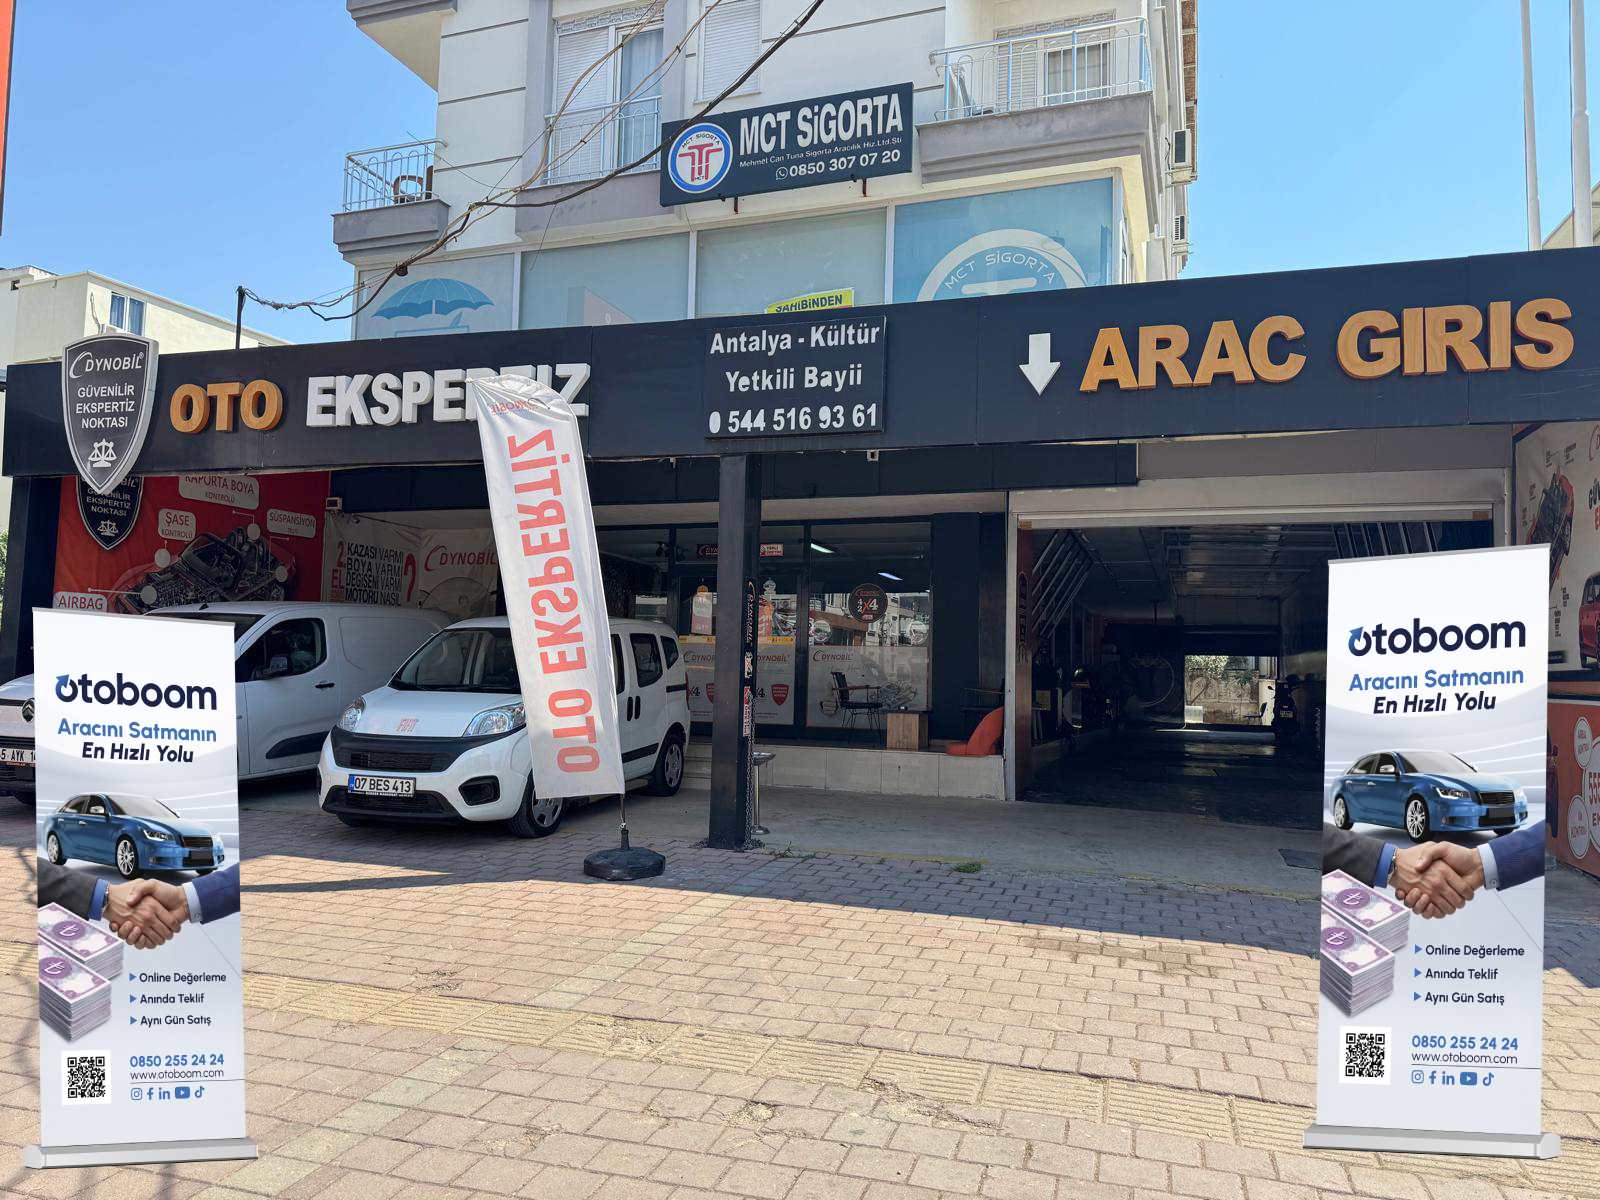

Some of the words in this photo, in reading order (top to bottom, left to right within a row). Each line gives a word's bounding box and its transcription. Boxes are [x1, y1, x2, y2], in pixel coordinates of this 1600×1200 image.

[740, 111, 791, 156] MCT
[740, 158, 768, 168] Mehmet
[770, 154, 784, 164] Can
[786, 152, 804, 161] Tuna
[806, 148, 832, 159] Sigorta
[789, 162, 825, 176] 0850
[829, 155, 856, 171] 307
[860, 152, 877, 167] 07
[882, 149, 900, 163] 20
[944, 260, 976, 290] MCT
[709, 330, 792, 356] Antalya
[810, 323, 880, 348] Kültür
[1079, 315, 1306, 393] ARAC
[1336, 297, 1576, 381] GIRIS
[725, 367, 795, 392] Yetkili
[804, 363, 862, 392] Bayii
[77, 383, 135, 397] GÜVENİLİR
[76, 398, 135, 413] EKSPERTİZ
[170, 378, 283, 434] OTO
[306, 363, 591, 427] EKSPEZ
[82, 417, 128, 428] NOKTASI
[709, 411, 721, 434] 0
[728, 408, 766, 433] 544
[772, 406, 812, 431] 516
[818, 405, 845, 429] 93
[852, 403, 877, 428] 61
[231, 480, 254, 494] BOYA
[165, 512, 190, 526] ŞASE
[347, 542, 377, 559] KAZASI
[347, 557, 373, 573] BOYA
[58, 595, 103, 609] AIRBAG
[1348, 618, 1526, 657] otoboom
[1349, 672, 1418, 691] Aracını
[1424, 669, 1524, 688] Satmanın
[55, 673, 217, 710] otoboom
[1373, 697, 1397, 715] En
[1403, 693, 1447, 713] Hızlı
[1456, 691, 1496, 712] Yolu
[58, 718, 123, 737] Aracını
[129, 721, 217, 742] Satmanın
[11, 750, 24, 761] AYK
[82, 742, 105, 759] En
[110, 743, 150, 762] Hızlı
[157, 745, 194, 763] Yolu
[354, 777, 367, 789] 07
[369, 779, 390, 791] BES
[392, 780, 411, 793] 413
[1425, 944, 1461, 956] Online
[1464, 945, 1525, 958] Değerleme
[139, 972, 171, 982] Online
[173, 972, 227, 985] Değerleme
[1425, 968, 1464, 979] Anında
[1468, 968, 1498, 980] Teklif
[140, 994, 176, 1004] Anında
[178, 993, 205, 1003] Teklif
[1425, 992, 1448, 1005] Aynı
[1451, 992, 1474, 1003] Gün
[1477, 992, 1505, 1005] Satış
[140, 1015, 162, 1028] Aynı
[164, 1014, 185, 1025] Gün
[187, 1015, 212, 1026] Satış
[1412, 1035, 1446, 1048] 0850
[1450, 1036, 1476, 1049] 255
[1480, 1037, 1497, 1050] 24
[1501, 1037, 1518, 1050] 24
[130, 1055, 161, 1067] 0850
[165, 1055, 188, 1066] 255
[191, 1054, 206, 1065] 24
[209, 1054, 224, 1065] 24
[1411, 1052, 1518, 1064] www.otoboom.com
[130, 1069, 224, 1080] www.otoboom.com
